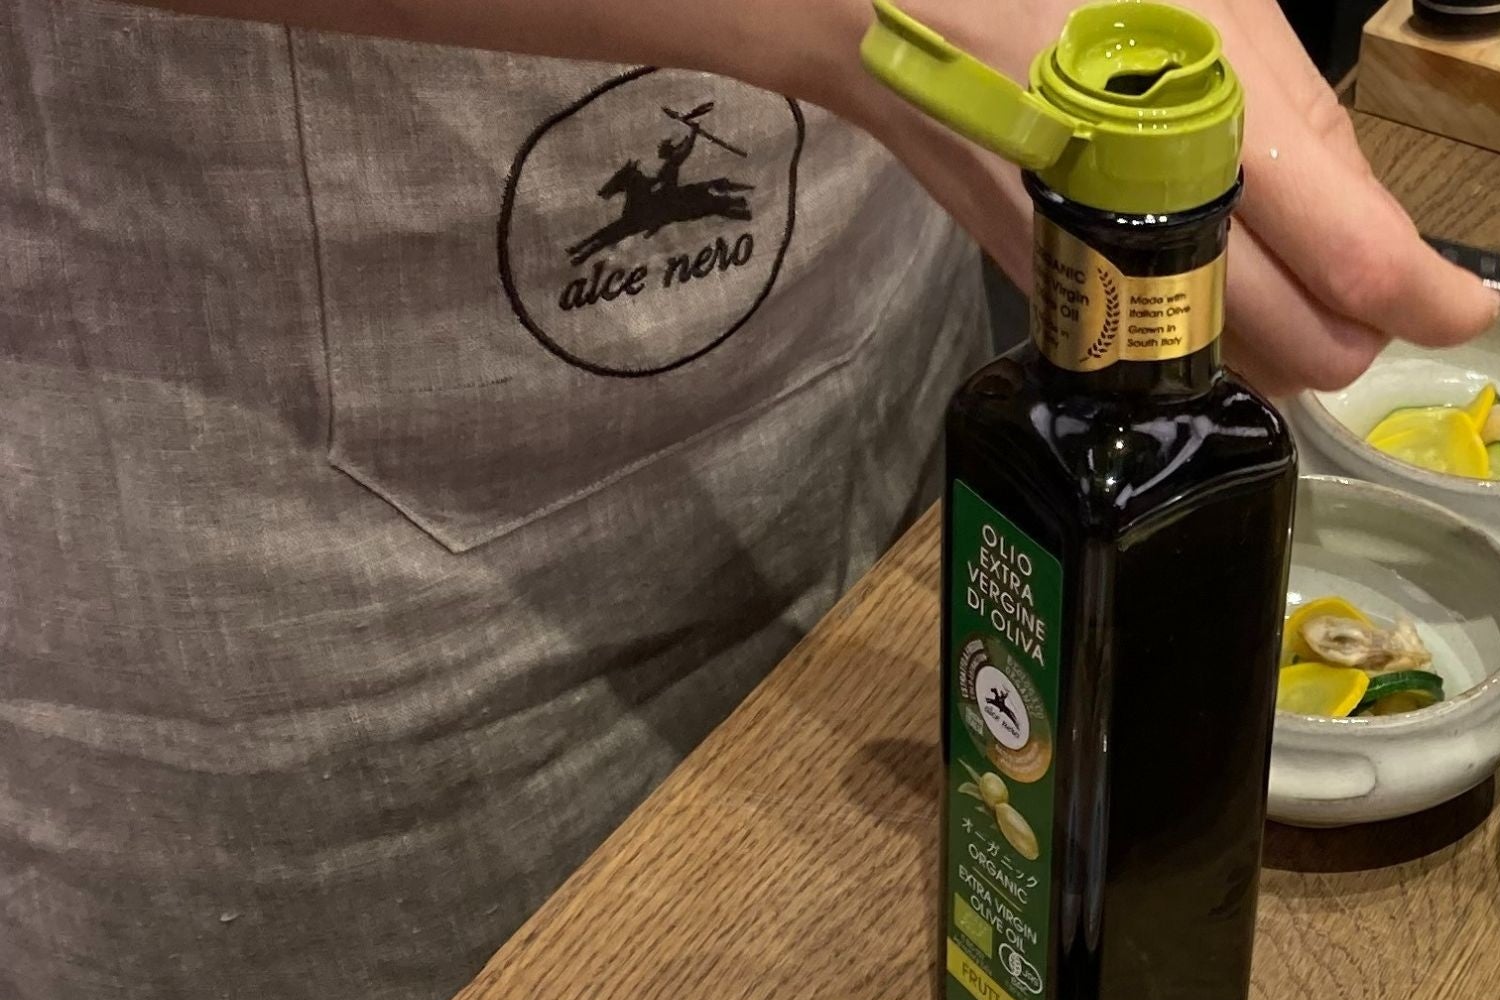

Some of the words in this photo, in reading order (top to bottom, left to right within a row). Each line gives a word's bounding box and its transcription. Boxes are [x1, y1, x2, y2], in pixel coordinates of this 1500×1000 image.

[558, 260, 648, 311] alce
[662, 232, 754, 288] nero
[1130, 295, 1164, 305] Made
[1127, 338, 1158, 348] South
[1161, 336, 1182, 346] Italy
[1128, 324, 1164, 334] Grown
[1166, 324, 1176, 333] in
[1129, 308, 1164, 318] Italian
[980, 545, 1034, 607] EXTRA
[982, 524, 1033, 577] OLIO
[967, 560, 1045, 641] VERGINE
[967, 586, 985, 617] DI
[991, 609, 1045, 668] OLIVA
[961, 817, 1038, 888] オーガニック
[968, 843, 1028, 905] ORGANIC
[959, 863, 993, 906] EXTRA
[994, 897, 1038, 945] VIRGIN
[970, 894, 1004, 935] OLIVE
[1005, 927, 1026, 955] OIL
